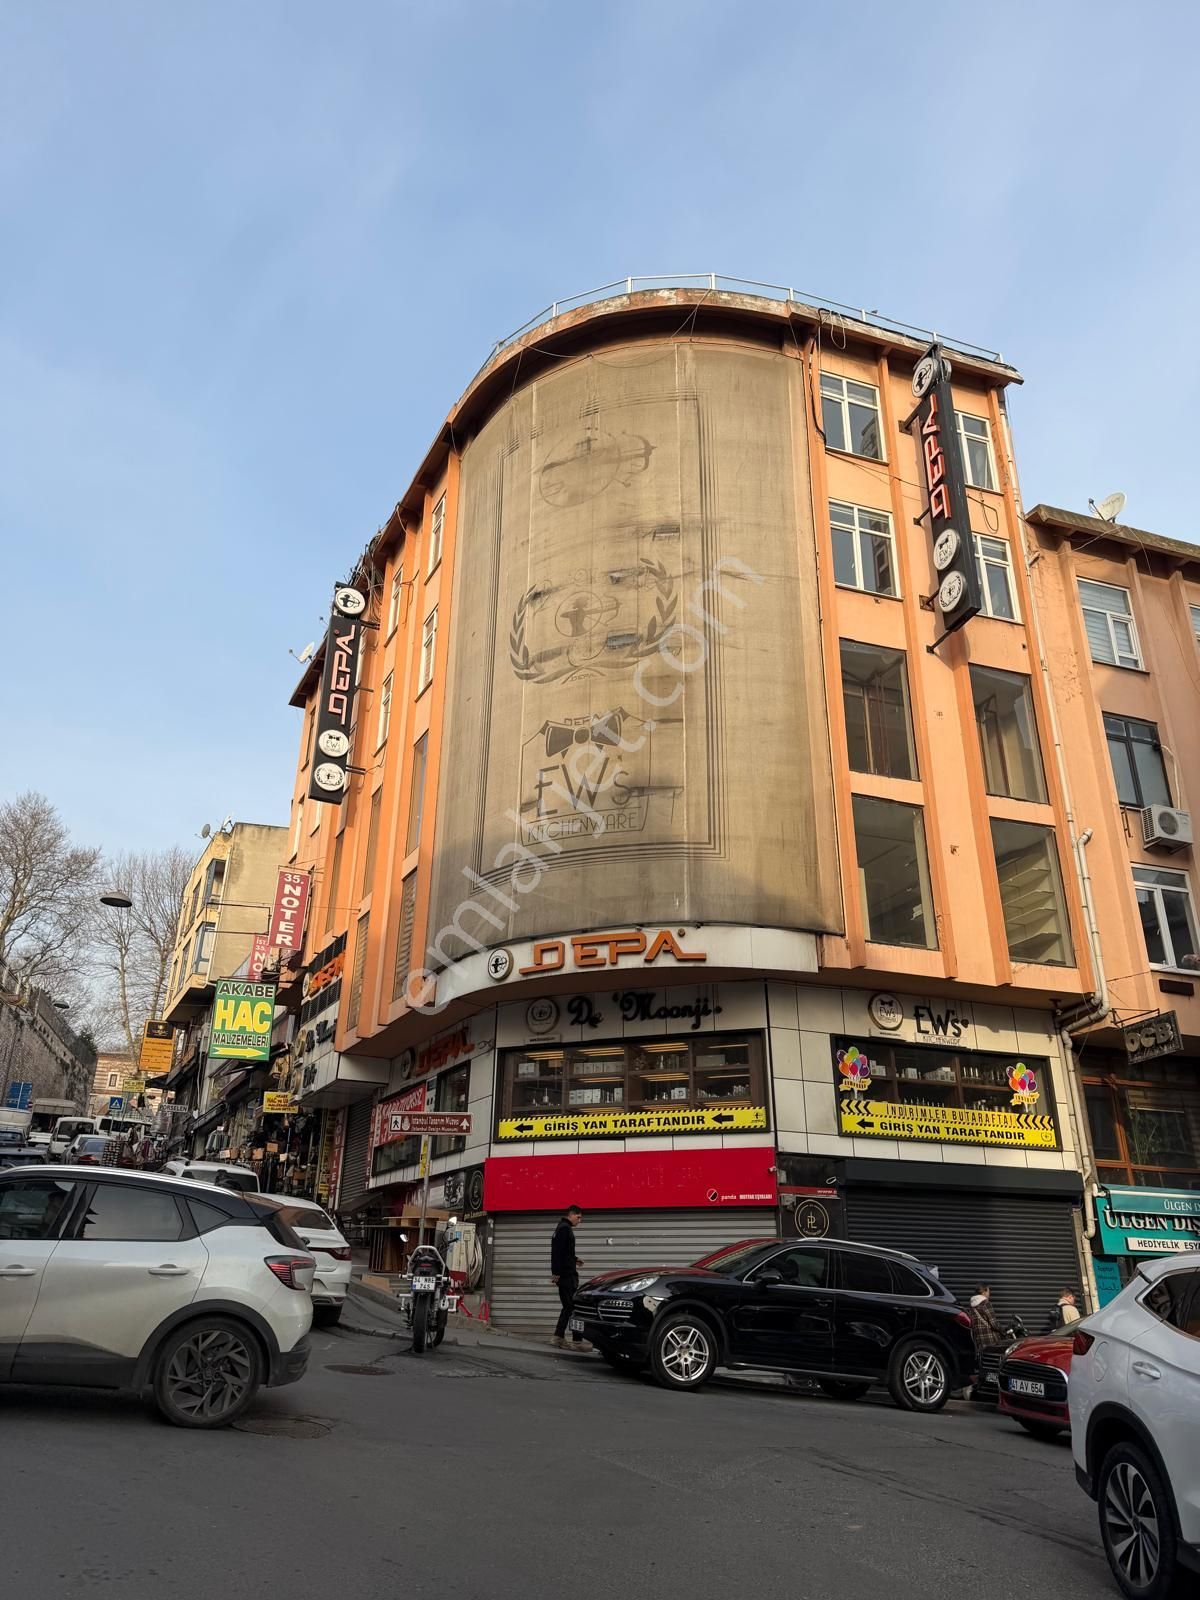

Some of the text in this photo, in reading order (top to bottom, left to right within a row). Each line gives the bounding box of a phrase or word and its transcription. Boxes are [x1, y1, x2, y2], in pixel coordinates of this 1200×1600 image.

[922, 393, 952, 519] DEPA
[328, 624, 356, 726] DEPA
[526, 811, 637, 842] KITCHENWARE
[284, 873, 304, 885] 35.
[275, 884, 302, 947] NOTER
[519, 929, 707, 975] DEPA
[218, 982, 275, 998] AKABE
[213, 998, 272, 1034] HAC
[212, 1032, 270, 1048] MALZEMELERİ
[543, 1115, 706, 1133] GİRİŞ YAN TARAFTANDIR
[880, 1121, 1026, 1141] GİRİŞ YAN TARAFTANDIR
[1163, 1199, 1193, 1211] ÜLGEN
[1137, 1238, 1180, 1249] HEDİYELİK
[1020, 1381, 1029, 1392] AV
[1031, 1383, 1043, 1393] 654
